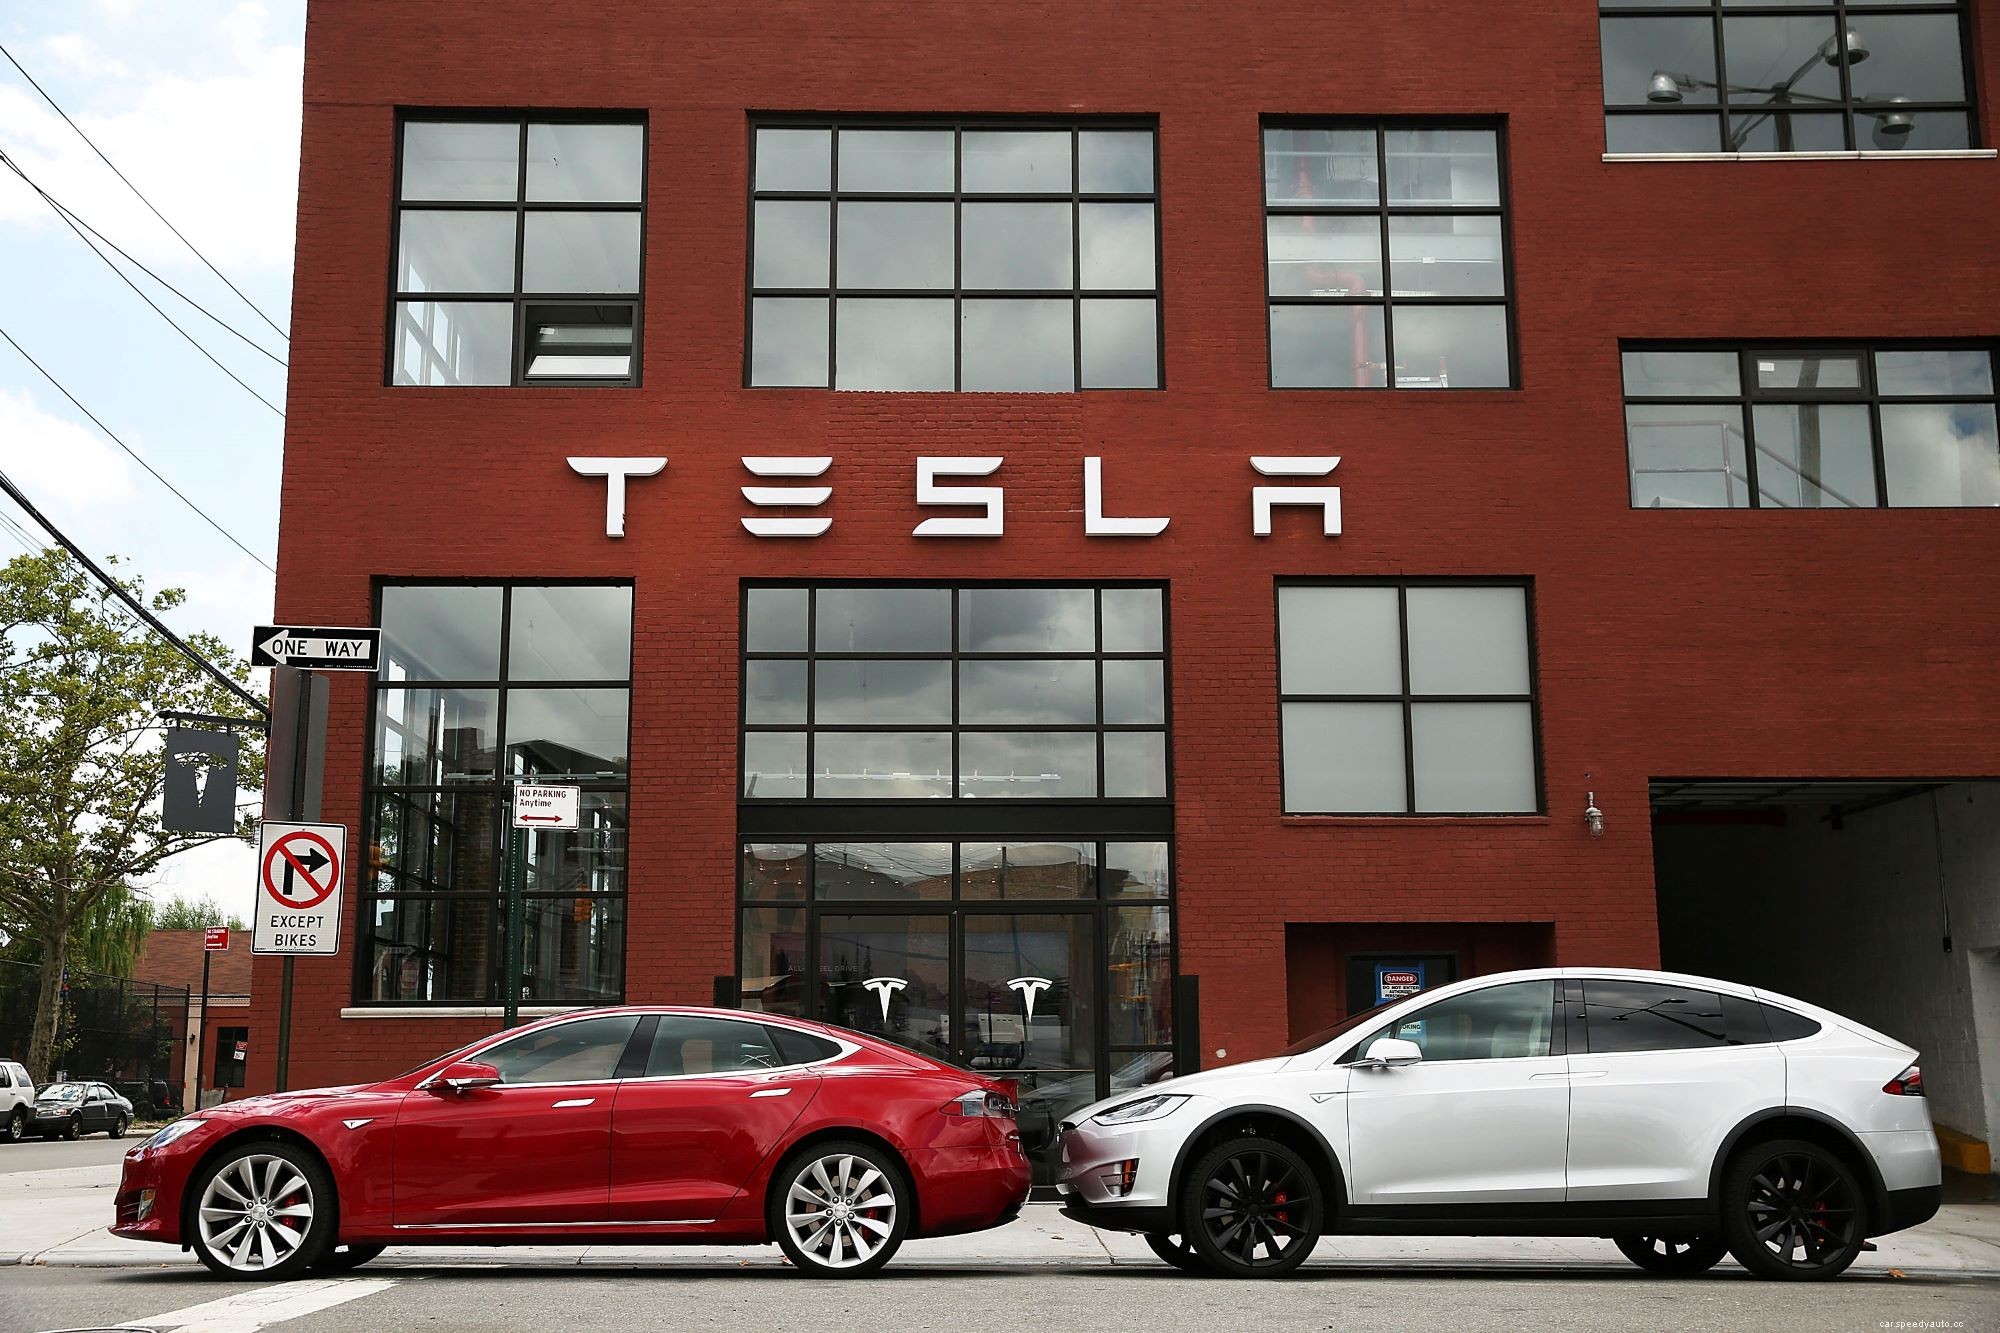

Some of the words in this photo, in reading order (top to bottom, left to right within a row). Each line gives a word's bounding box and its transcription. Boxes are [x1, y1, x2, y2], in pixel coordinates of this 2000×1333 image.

[566, 456, 1342, 538] TESLA
[272, 639, 308, 656] ONE
[325, 641, 363, 657] WAY
[519, 789, 531, 797] NO
[532, 789, 567, 799] PARKING
[519, 799, 552, 808] Anytime
[270, 915, 324, 929] EXCEPT
[274, 934, 317, 947] BIKES
